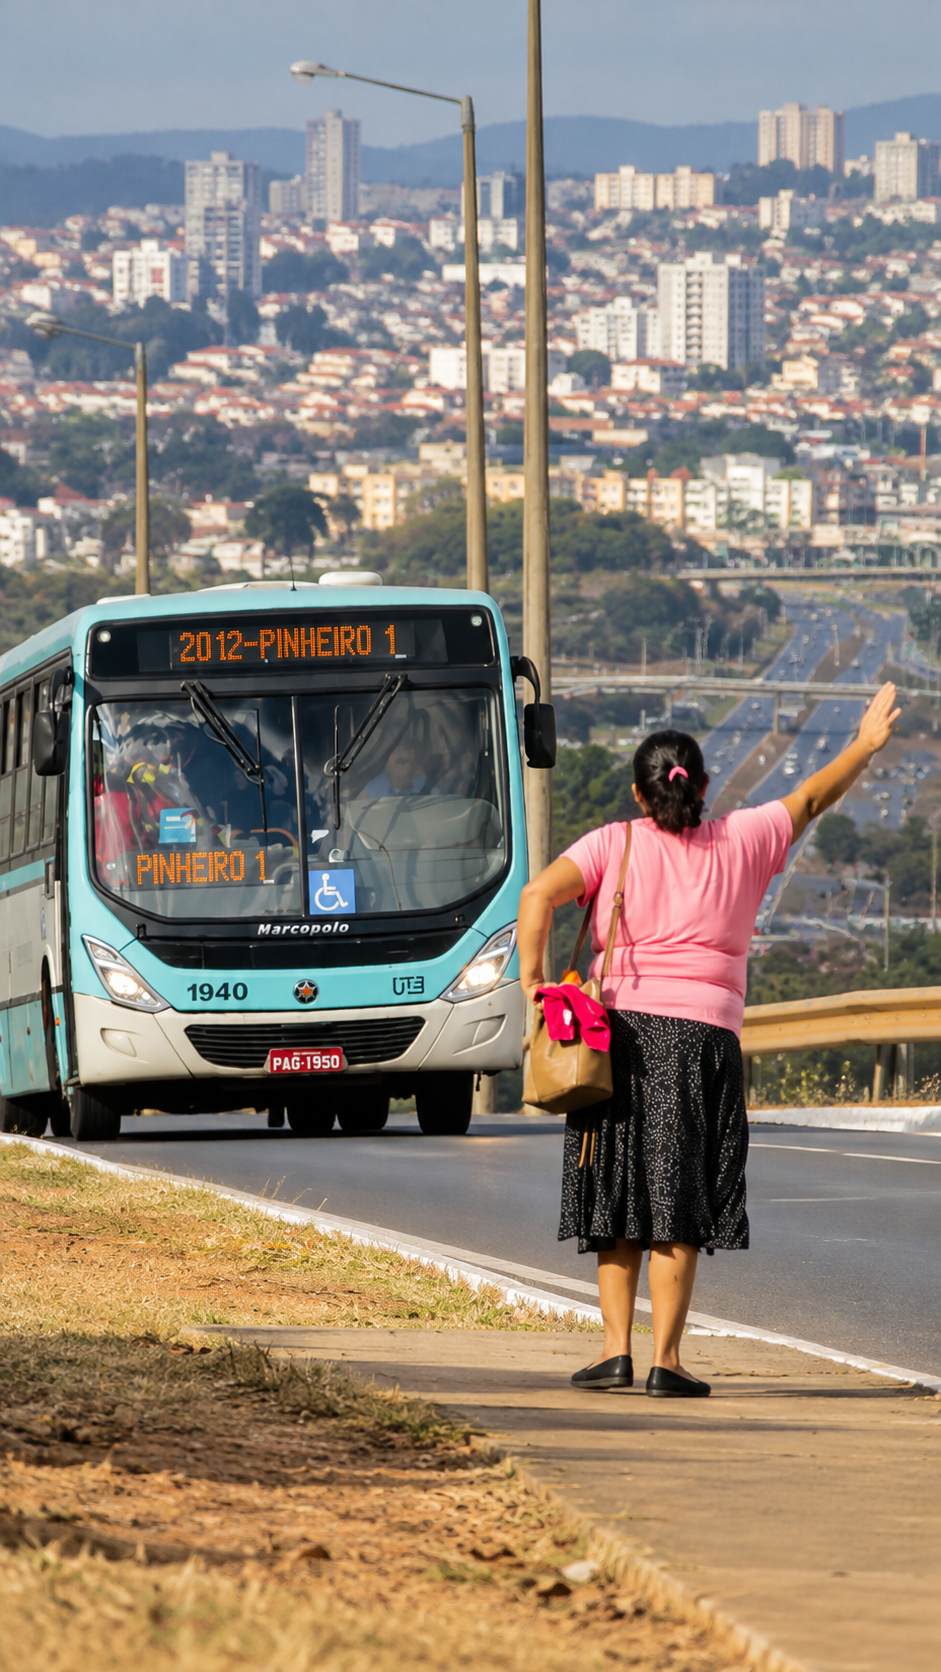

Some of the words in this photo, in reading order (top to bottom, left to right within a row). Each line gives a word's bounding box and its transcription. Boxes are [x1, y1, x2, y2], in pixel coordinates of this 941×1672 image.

[180, 625, 372, 662] 2012-PINHEIRO
[385, 624, 396, 655] 1
[137, 850, 245, 885] PINHEIRO
[255, 850, 265, 881] 1
[257, 922, 350, 936] Marcopolo
[187, 982, 248, 1002] 1940
[273, 1055, 340, 1071] PAG-1950
